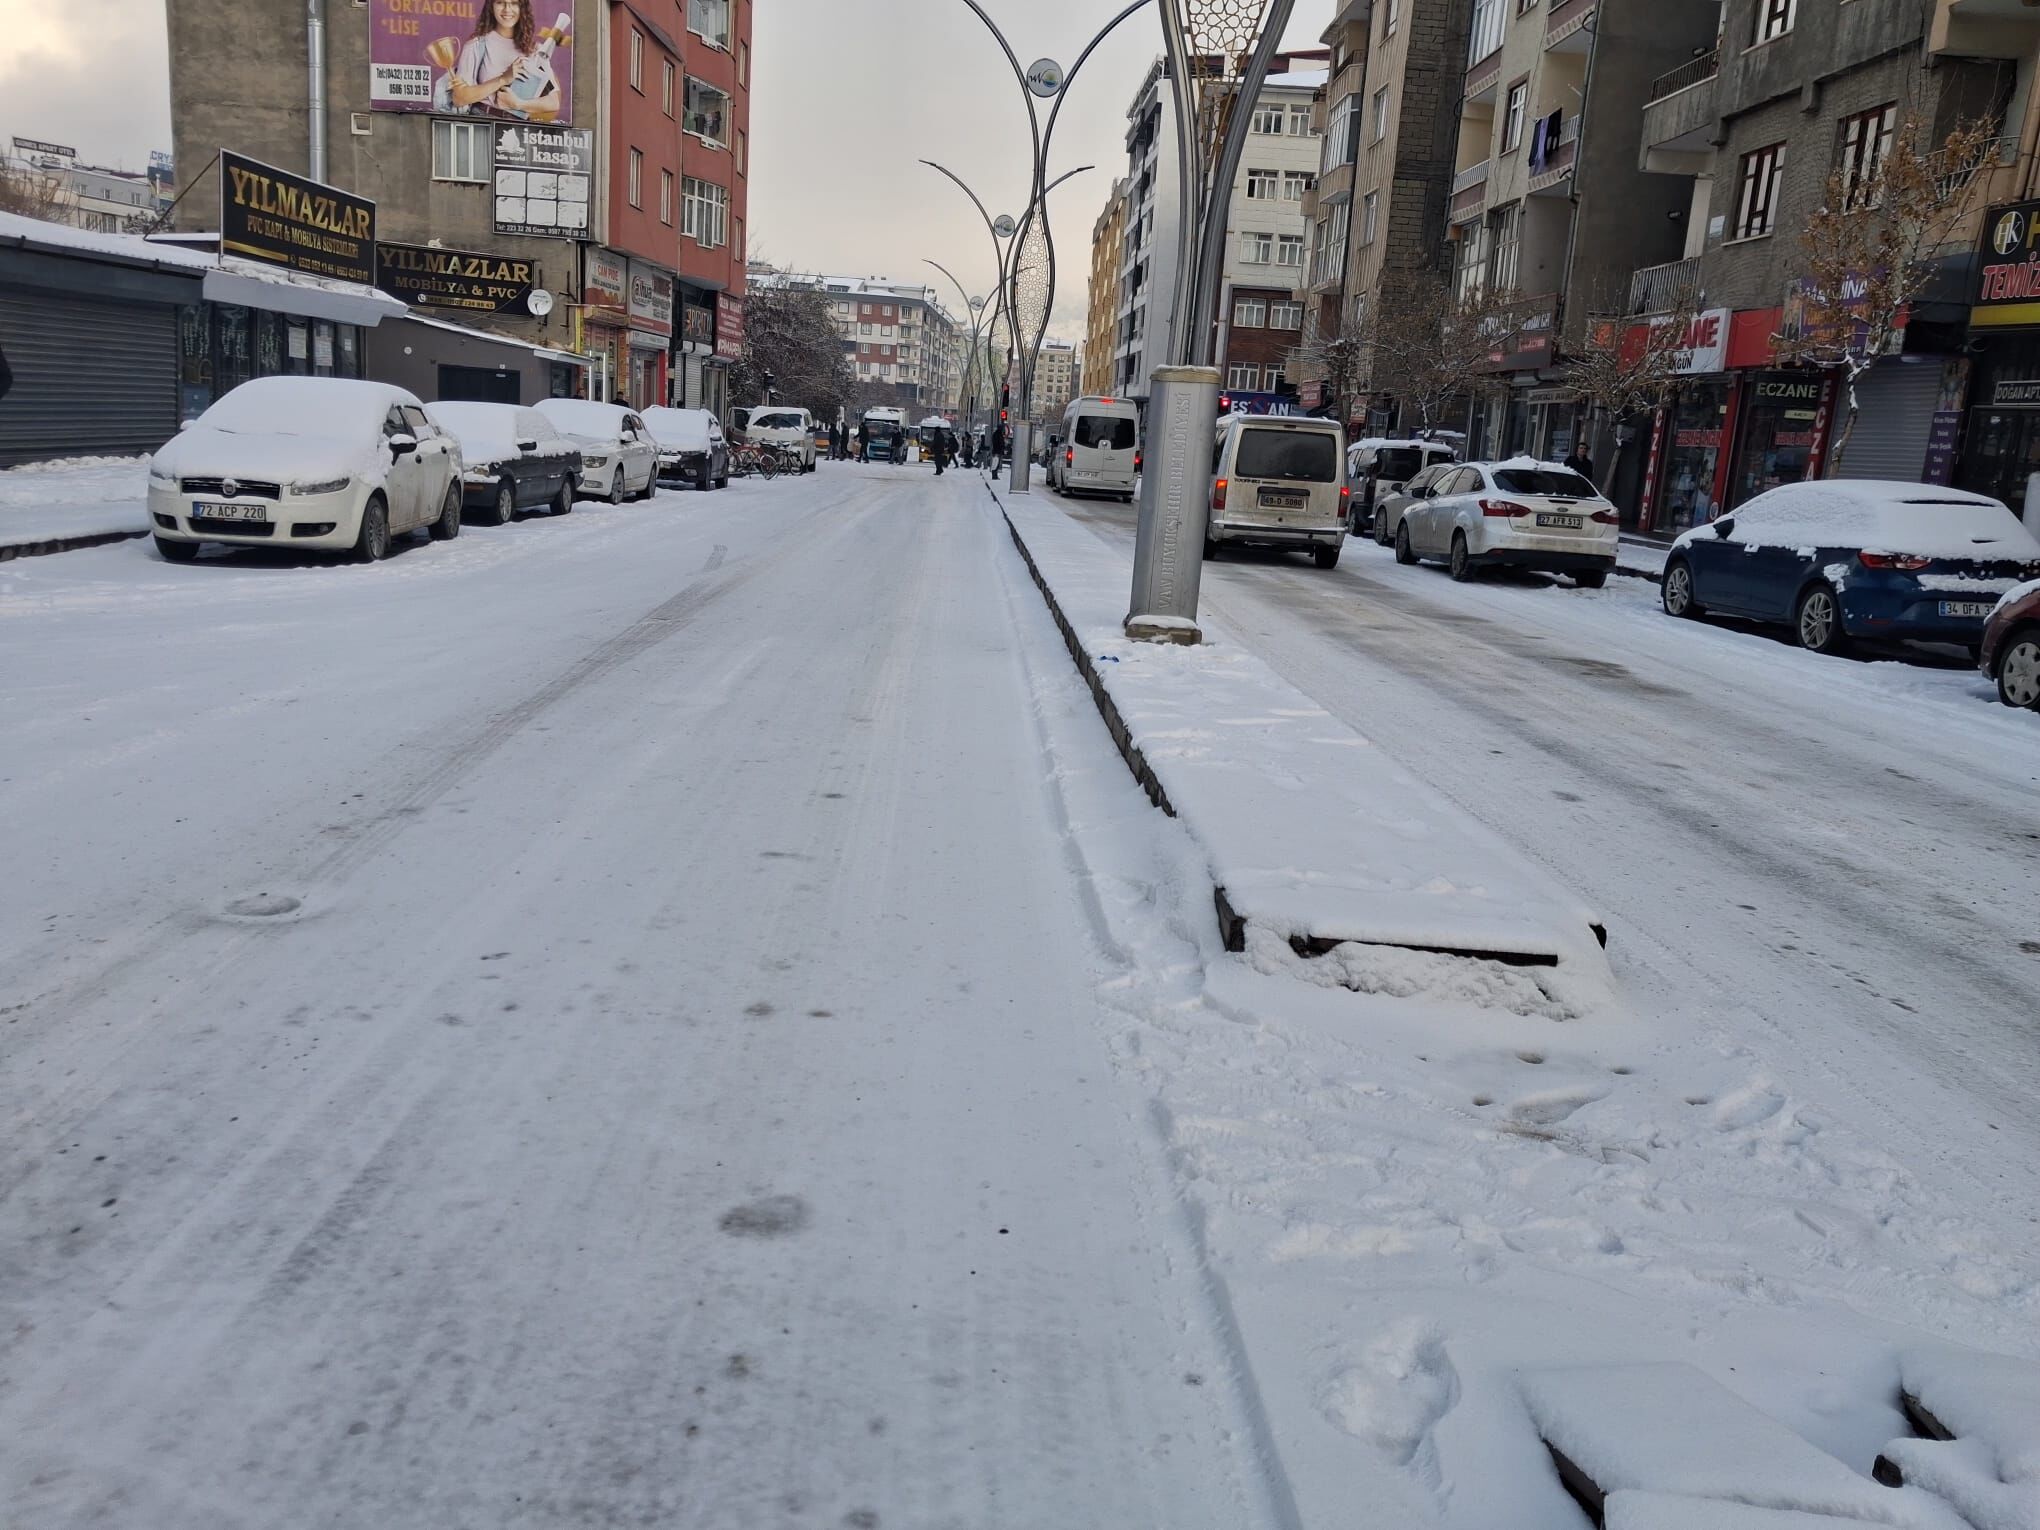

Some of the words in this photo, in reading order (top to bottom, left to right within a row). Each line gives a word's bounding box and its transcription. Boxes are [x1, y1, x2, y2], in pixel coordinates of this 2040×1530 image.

[522, 127, 590, 150] istanbul
[532, 146, 580, 169] kasap
[228, 165, 371, 241] YILMAZLAR
[247, 214, 263, 235] PVC
[264, 218, 283, 241] KAPI
[291, 227, 322, 252] MOBİLYA
[377, 247, 531, 284] YILMAZLAR
[394, 276, 468, 296] MOBİLYA
[471, 284, 484, 296] &
[488, 286, 518, 300] PVC
[1756, 381, 1819, 399] ECZANE
[200, 504, 213, 517] 72
[217, 505, 238, 518] ACP
[243, 506, 264, 519] 220
[1540, 515, 1550, 524] 27
[1946, 603, 1958, 615] 34
